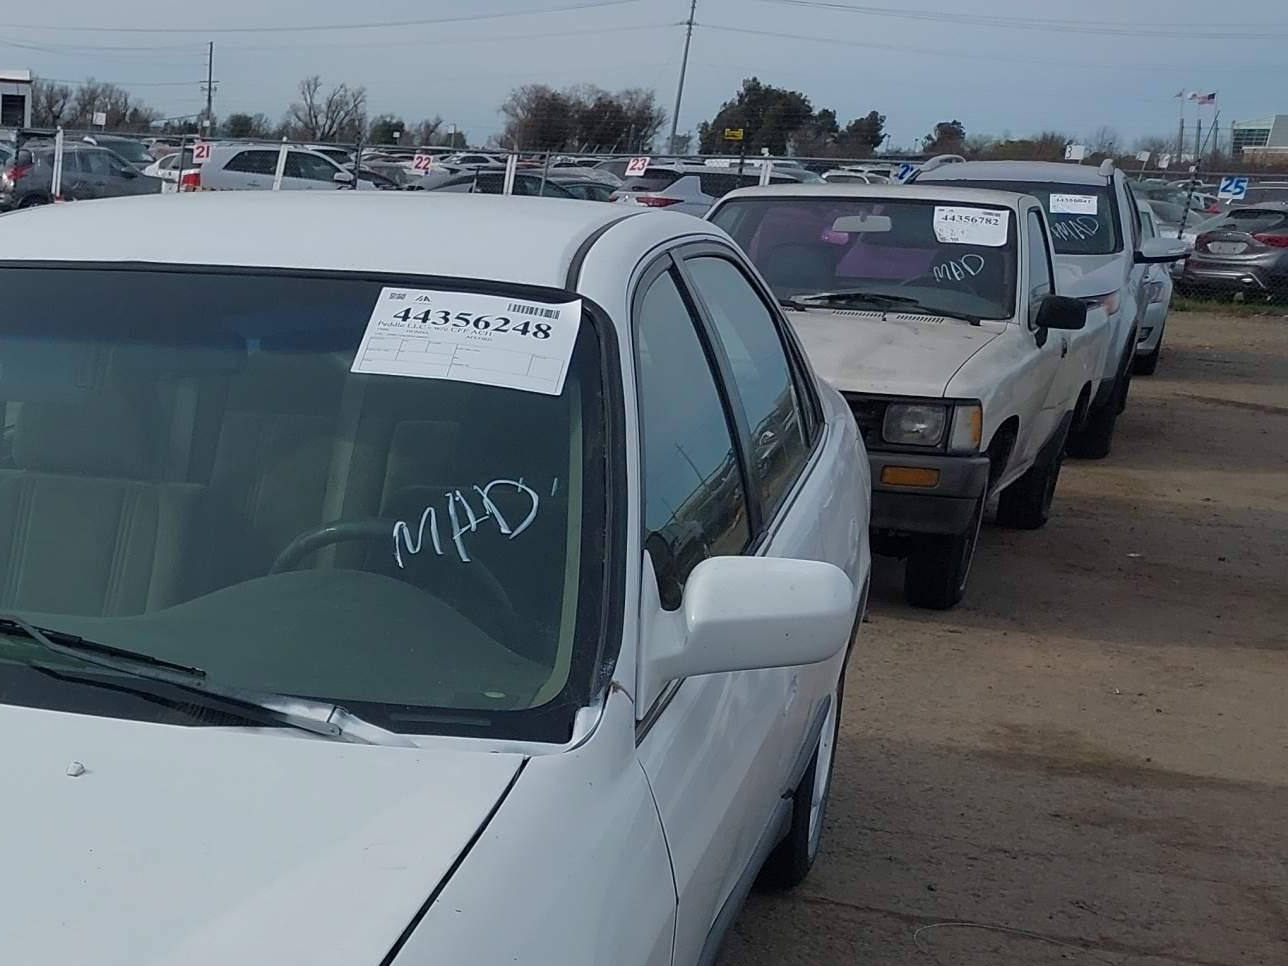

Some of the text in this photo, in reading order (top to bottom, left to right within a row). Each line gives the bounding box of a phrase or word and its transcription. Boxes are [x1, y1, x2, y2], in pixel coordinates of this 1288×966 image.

[195, 145, 210, 159] 21
[414, 156, 431, 170] 22
[629, 158, 647, 171] 23
[1220, 178, 1246, 195] 25
[941, 214, 1000, 226] 44356782
[933, 254, 985, 282] MAD
[393, 306, 553, 340] 44356248
[392, 476, 540, 569] MAD
